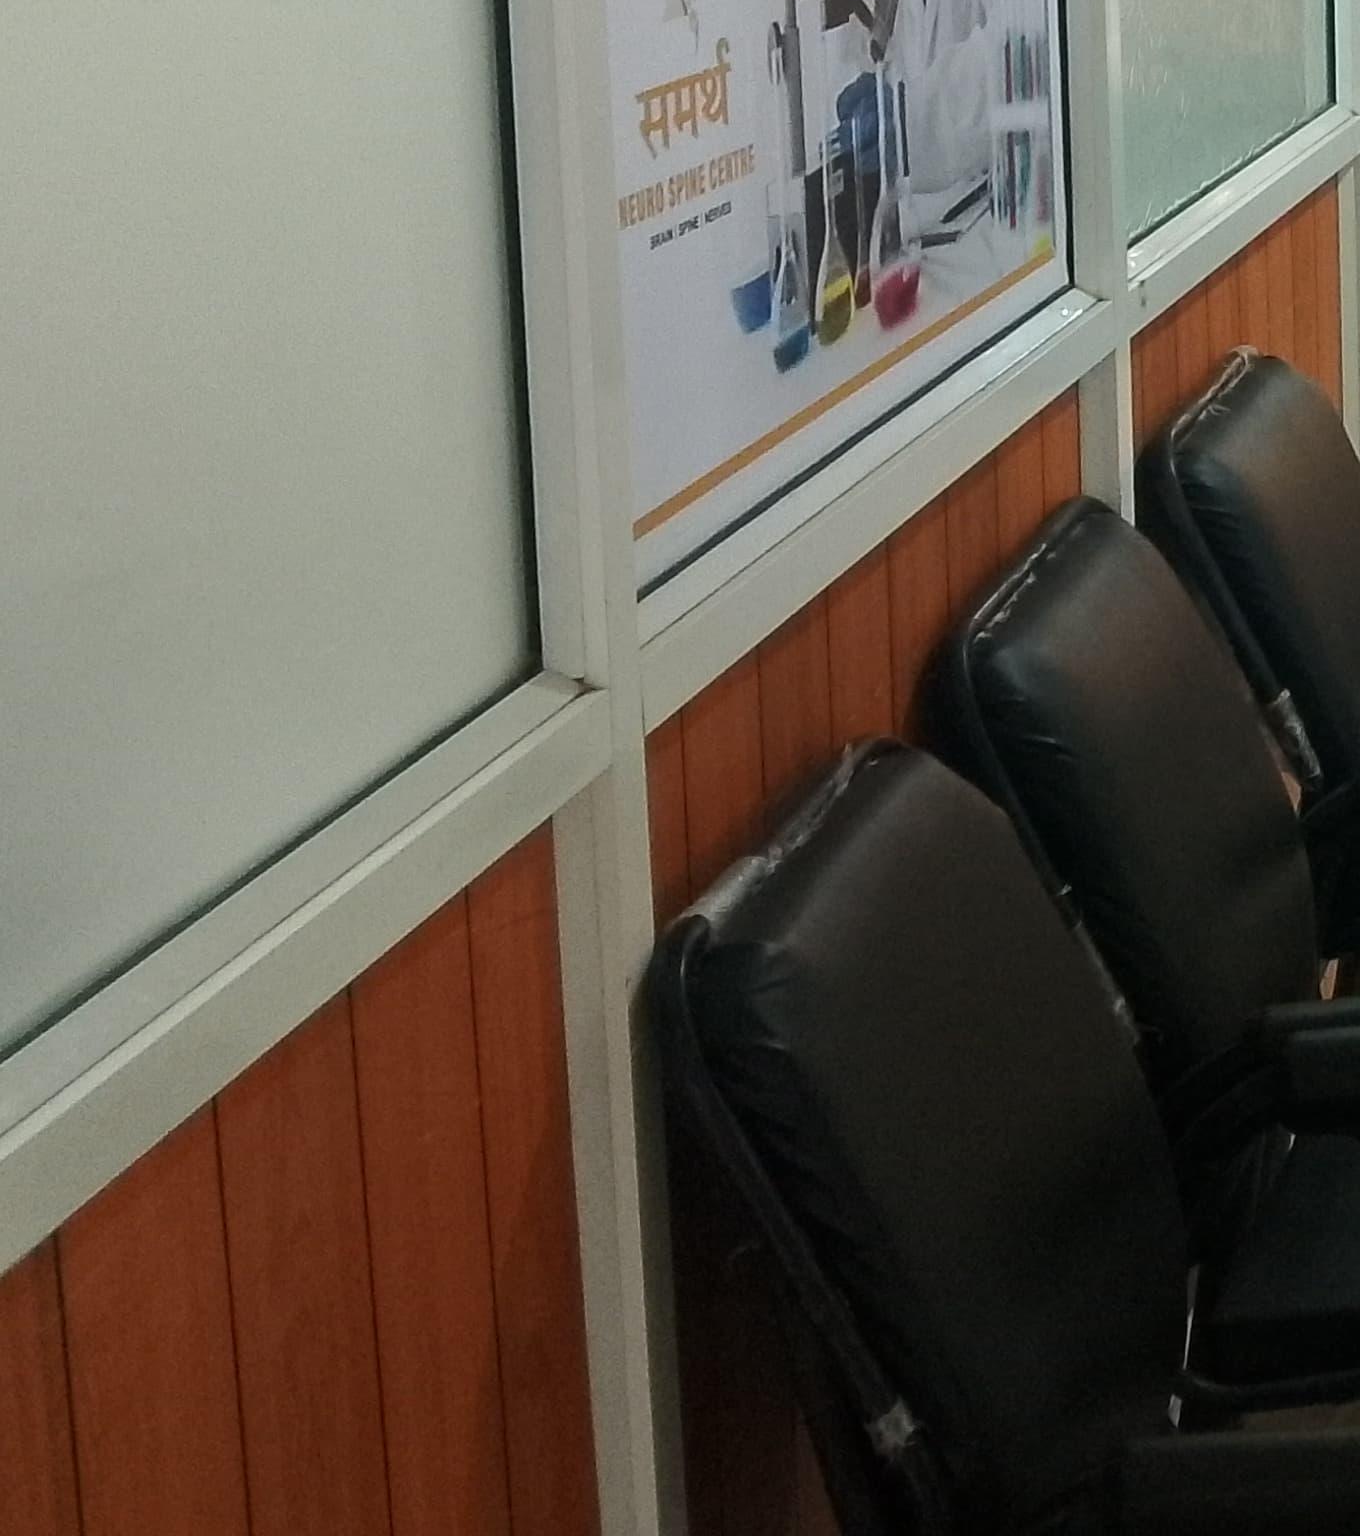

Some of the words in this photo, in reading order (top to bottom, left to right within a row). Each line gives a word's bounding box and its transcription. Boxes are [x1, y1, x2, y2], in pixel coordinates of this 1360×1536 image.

[634, 37, 732, 159] समर्थ
[618, 181, 665, 230] NEURO
[667, 164, 706, 208] SPINE
[709, 144, 756, 190] CENTRE
